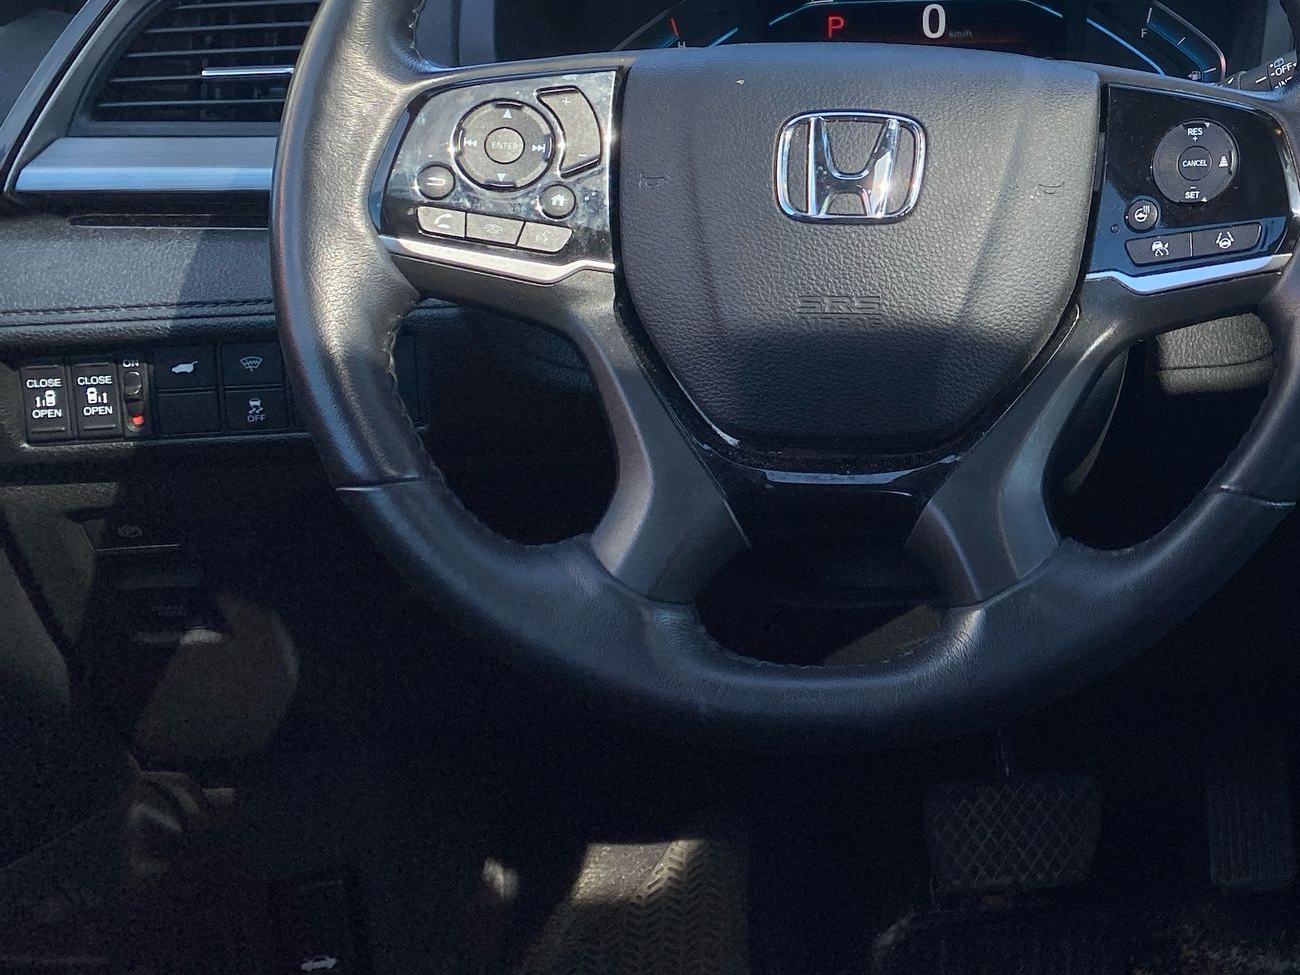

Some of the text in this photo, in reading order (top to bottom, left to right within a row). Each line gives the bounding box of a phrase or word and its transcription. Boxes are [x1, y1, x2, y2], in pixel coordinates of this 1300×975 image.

[922, 3, 972, 39] 0 km/h
[827, 16, 845, 39] P
[1141, 28, 1148, 38] F
[1275, 62, 1292, 76] OFF
[1187, 128, 1203, 136] RES
[491, 141, 519, 150] ENTER
[1184, 191, 1200, 199] SET
[797, 295, 881, 315] SRS
[122, 359, 140, 368] ON
[26, 378, 62, 388] CLOSE
[77, 375, 113, 386] CLOSE
[32, 408, 62, 419] OPEN
[83, 405, 113, 416] OPEN
[247, 413, 266, 423] OFF
